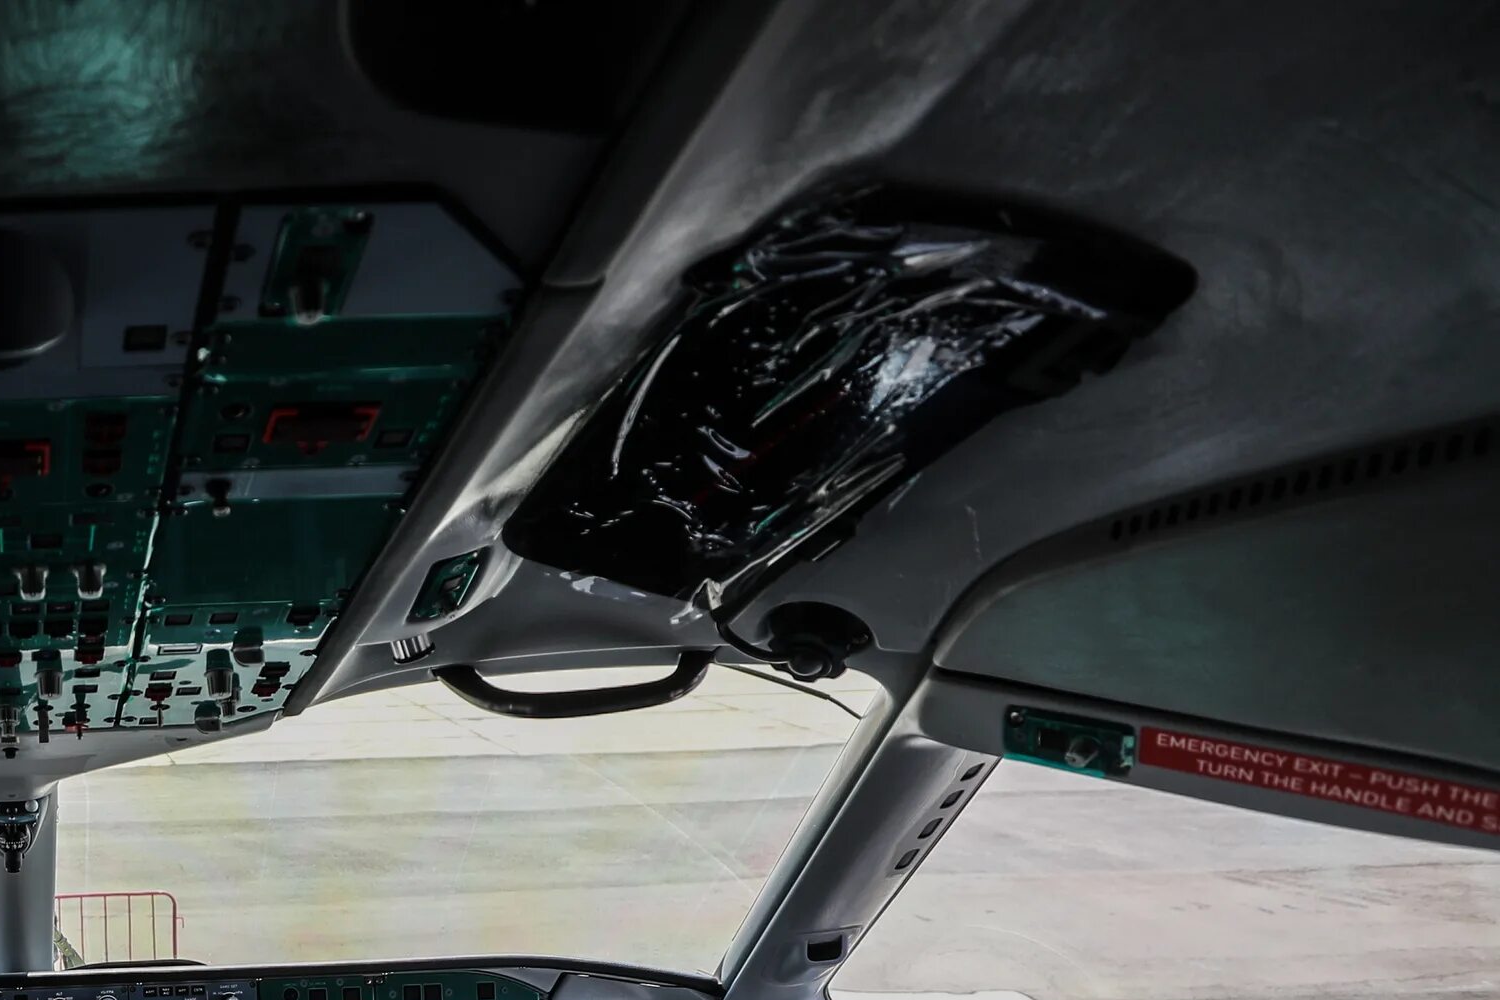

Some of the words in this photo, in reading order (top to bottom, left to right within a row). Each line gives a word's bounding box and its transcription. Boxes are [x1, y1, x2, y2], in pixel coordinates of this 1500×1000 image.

[1156, 733, 1288, 768] EMERGENCY
[1293, 756, 1346, 779] EXIT
[1369, 769, 1440, 799] PUSH
[1448, 783, 1497, 809] THE
[1196, 757, 1254, 783] TURN
[1261, 772, 1303, 792] THE
[1309, 781, 1412, 814] HANDLE
[1415, 803, 1475, 827] AND
